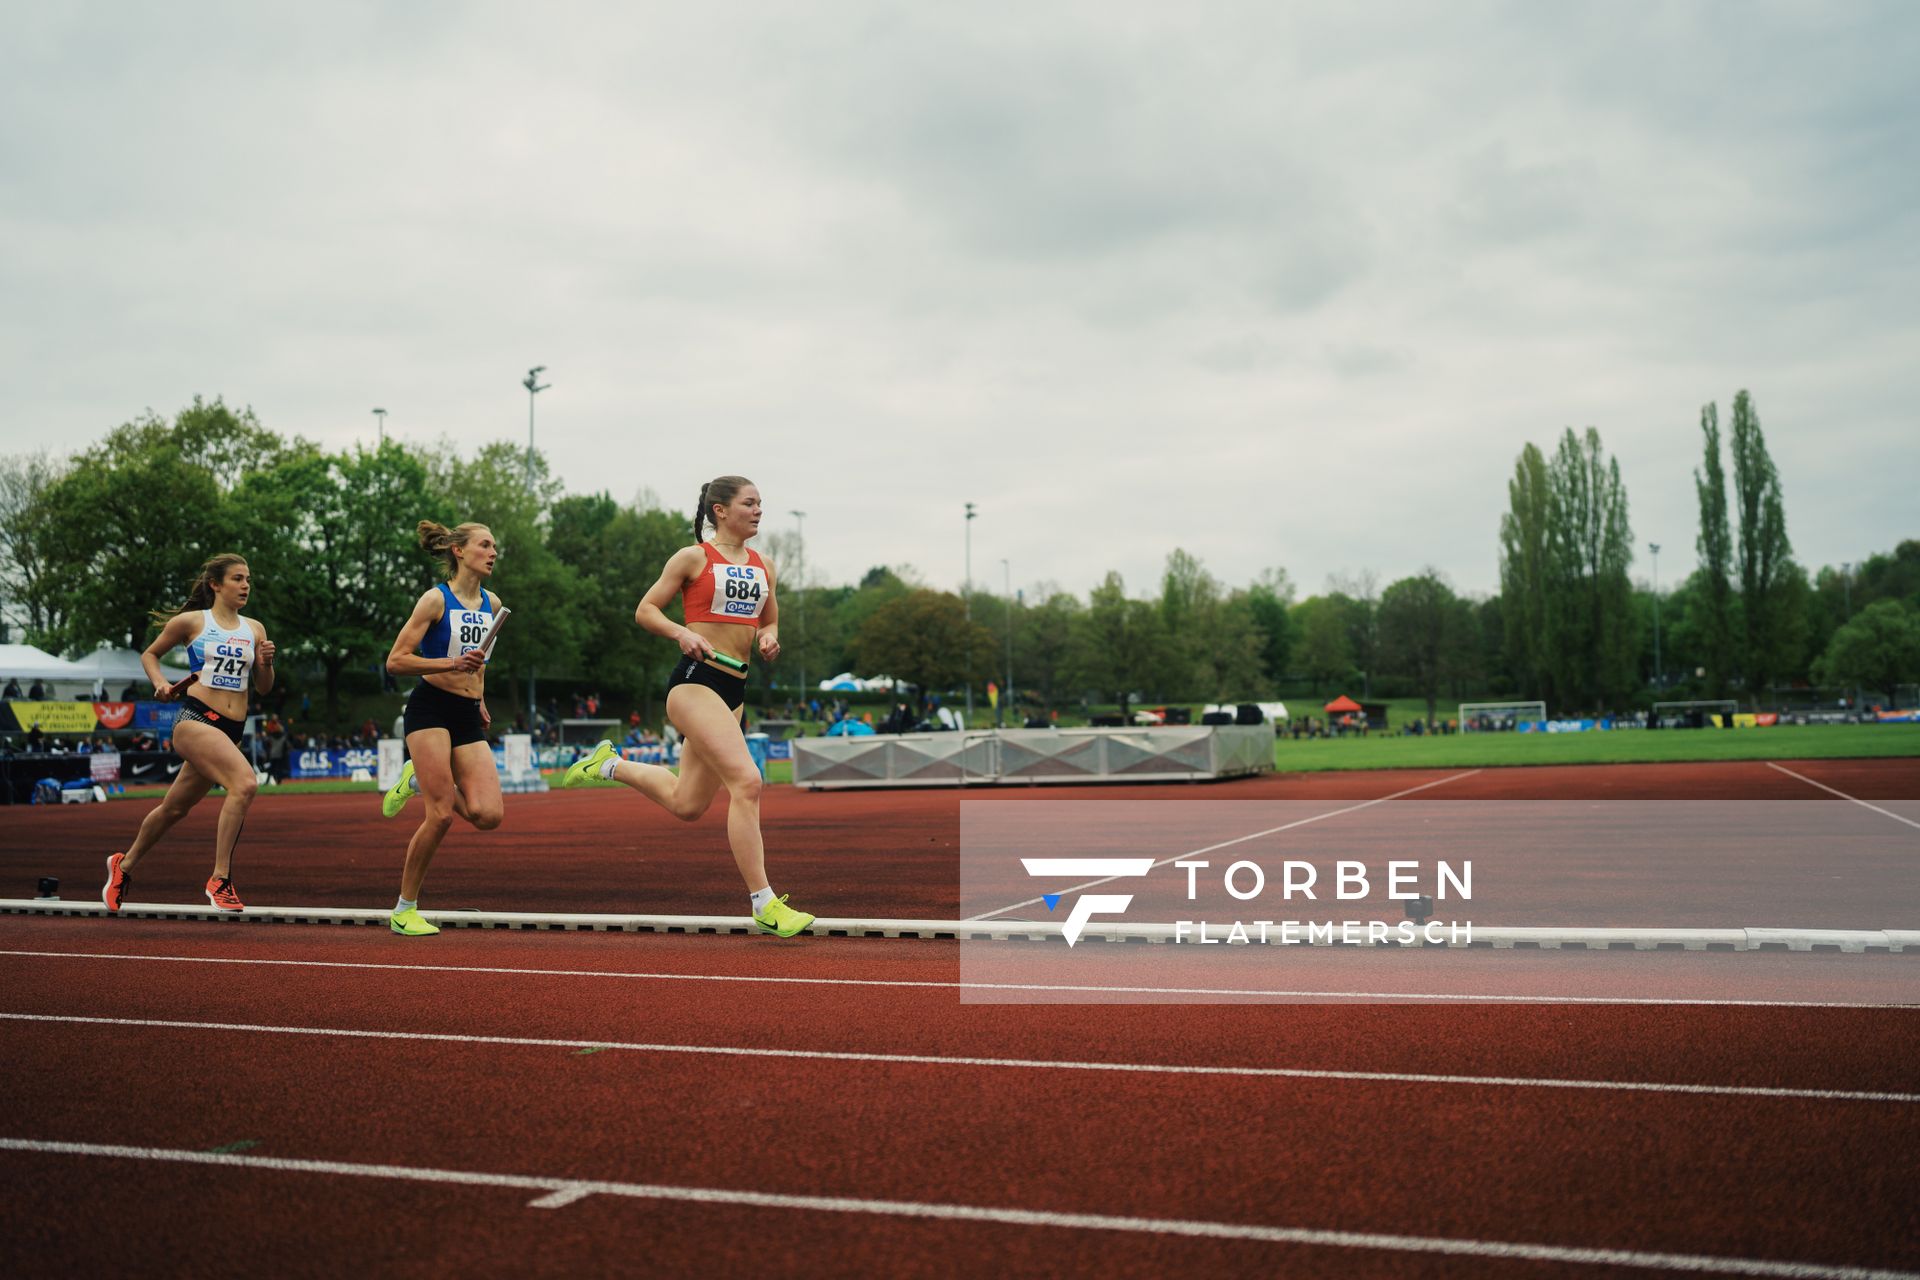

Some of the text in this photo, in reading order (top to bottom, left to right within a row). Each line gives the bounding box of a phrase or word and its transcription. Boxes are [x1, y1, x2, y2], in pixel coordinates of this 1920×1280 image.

[727, 566, 754, 580] GLS
[725, 579, 761, 602] 684
[461, 612, 484, 625] GLS
[216, 644, 243, 658] GLS
[213, 656, 247, 677] 747
[299, 751, 329, 770] GLS
